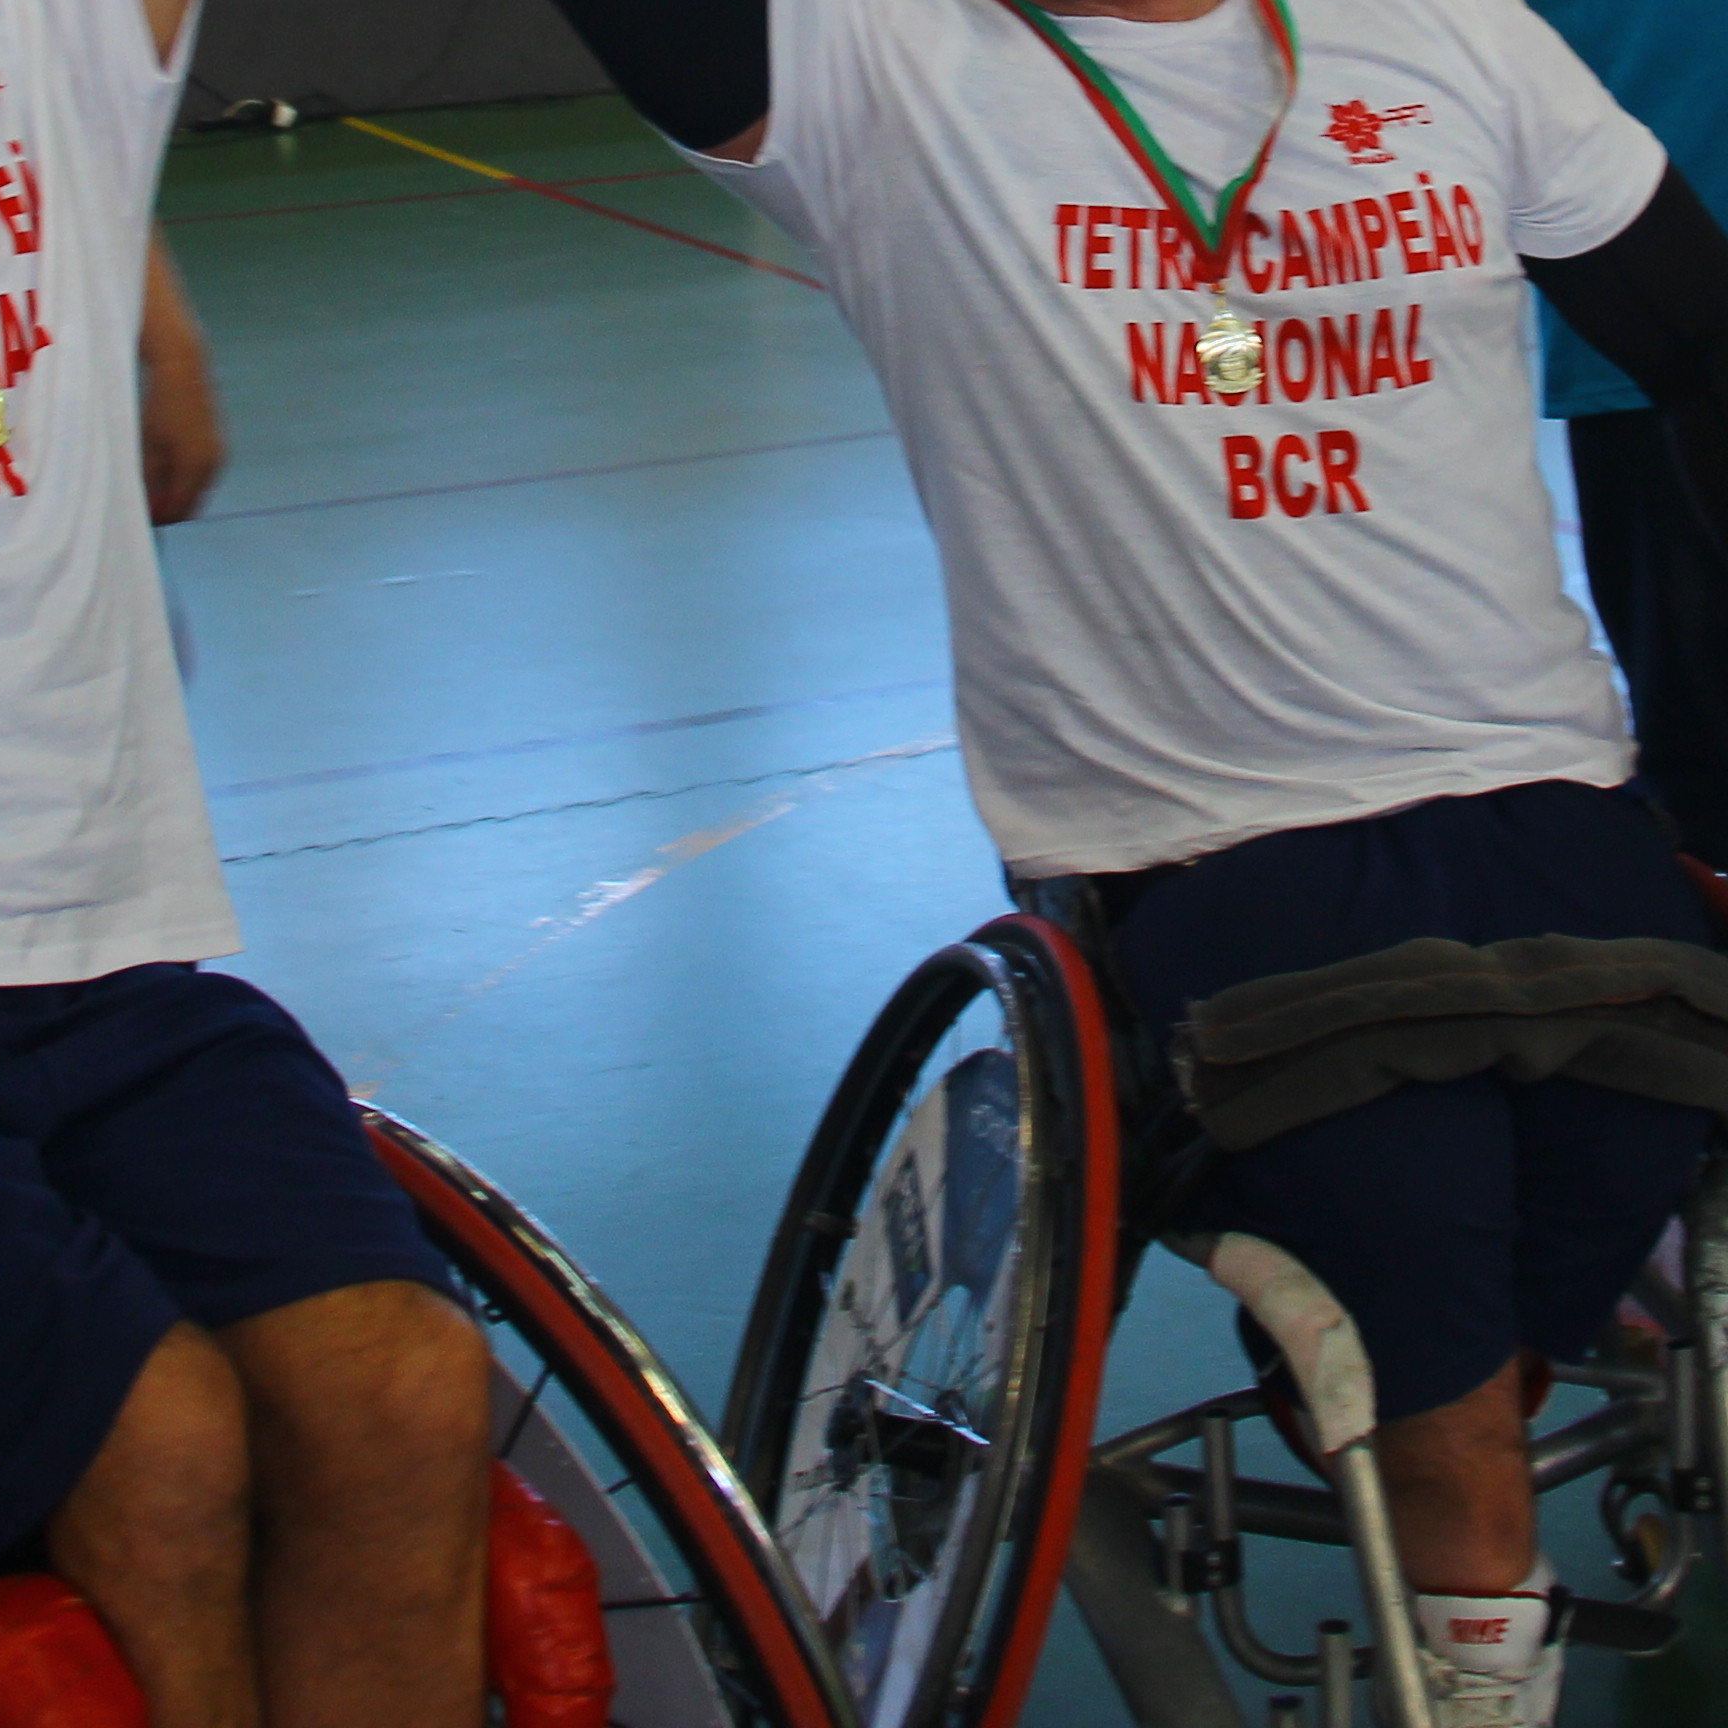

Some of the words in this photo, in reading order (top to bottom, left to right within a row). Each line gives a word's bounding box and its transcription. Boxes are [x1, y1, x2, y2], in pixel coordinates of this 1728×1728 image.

[1238, 171, 1485, 295] CAMPEÃO
[1125, 303, 1434, 406] NAIONAL
[1221, 429, 1371, 520] BCR
